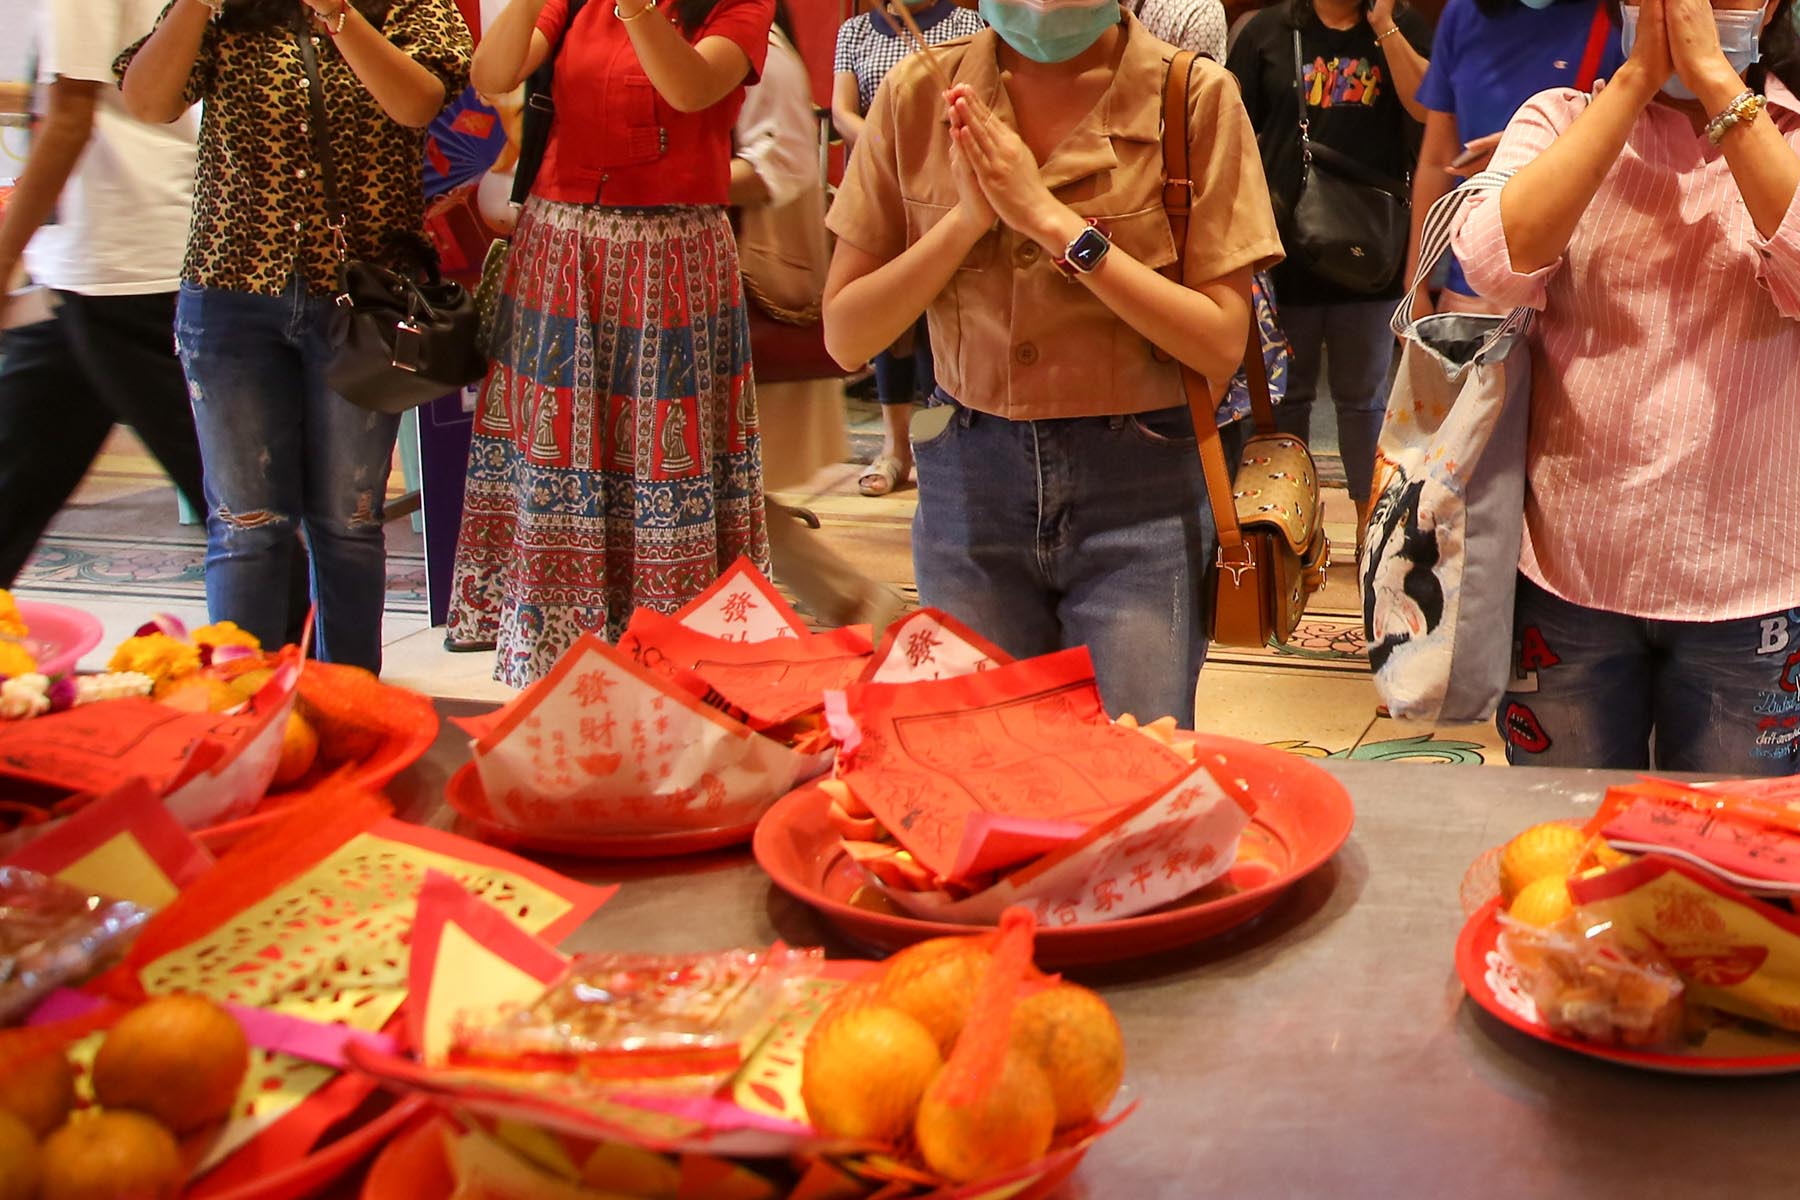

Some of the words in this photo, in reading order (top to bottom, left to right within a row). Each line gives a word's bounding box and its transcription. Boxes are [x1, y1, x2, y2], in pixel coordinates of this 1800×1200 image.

[1520, 626, 1561, 671] A
[1755, 615, 1790, 655] B
[571, 669, 619, 747] 發財
